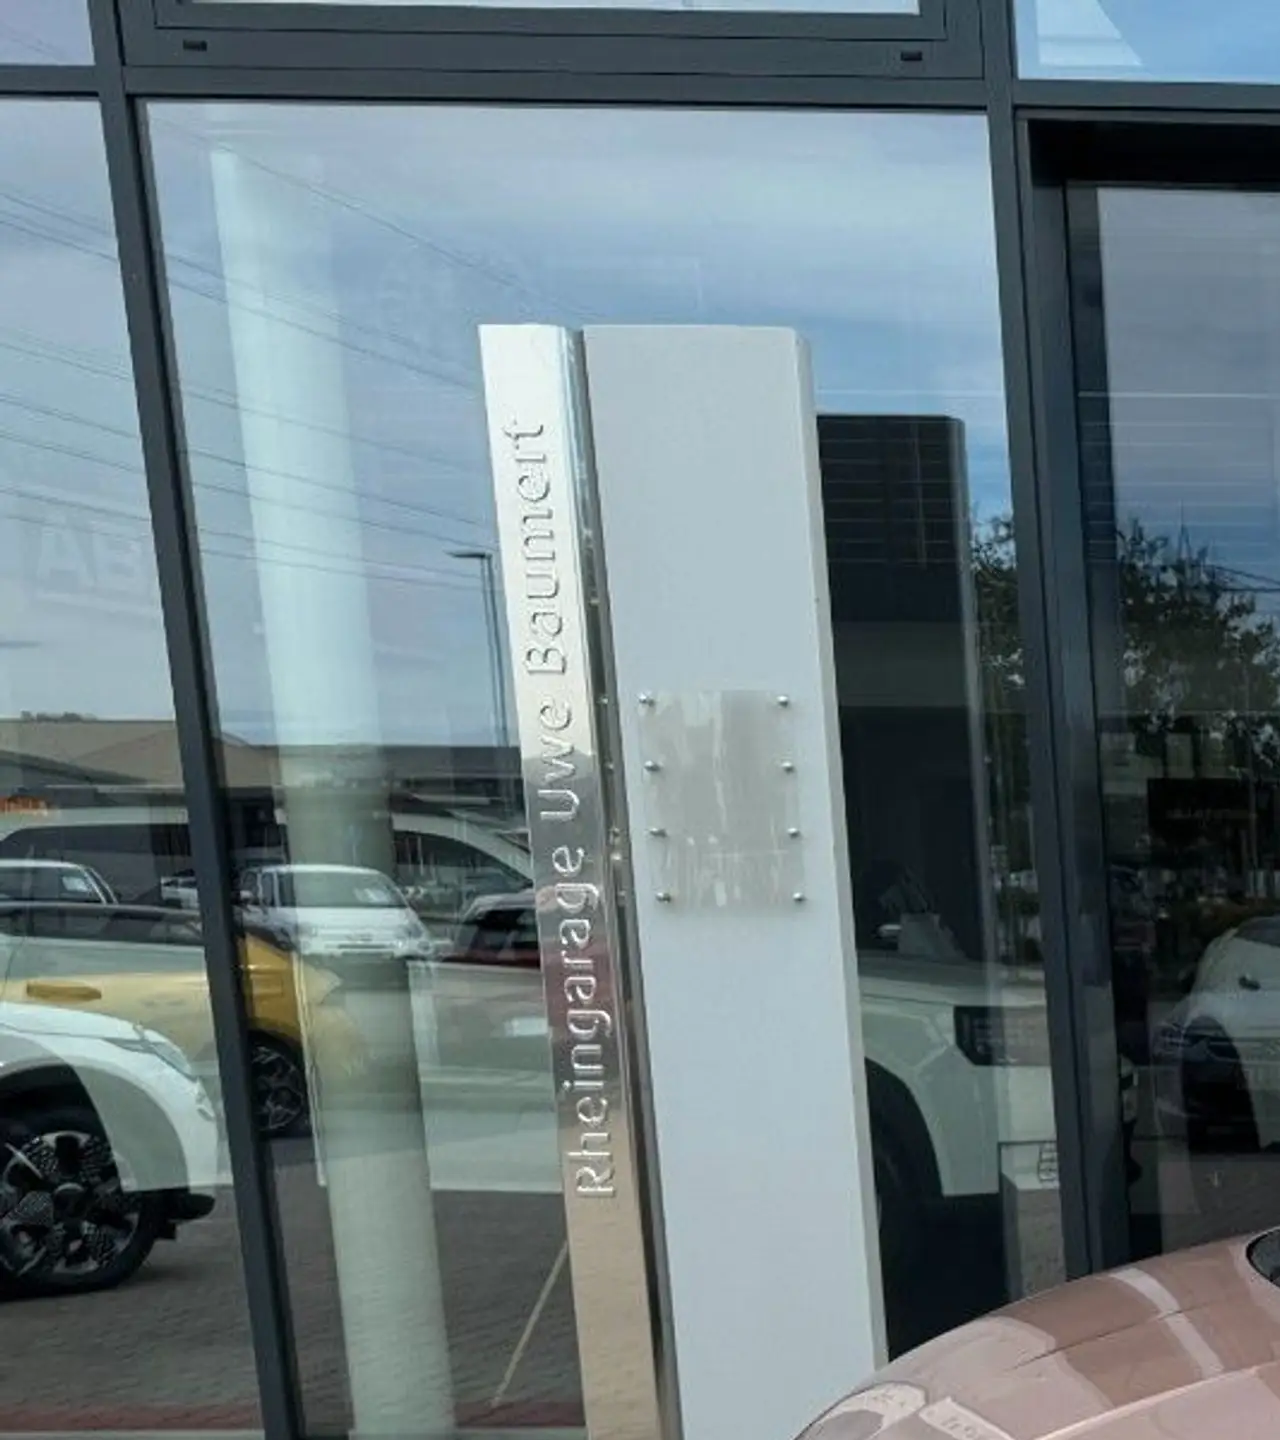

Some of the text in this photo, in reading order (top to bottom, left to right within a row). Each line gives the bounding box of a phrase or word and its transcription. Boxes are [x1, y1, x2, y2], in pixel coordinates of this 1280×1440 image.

[501, 420, 614, 1197] Rheingarage Uwe Baumert
